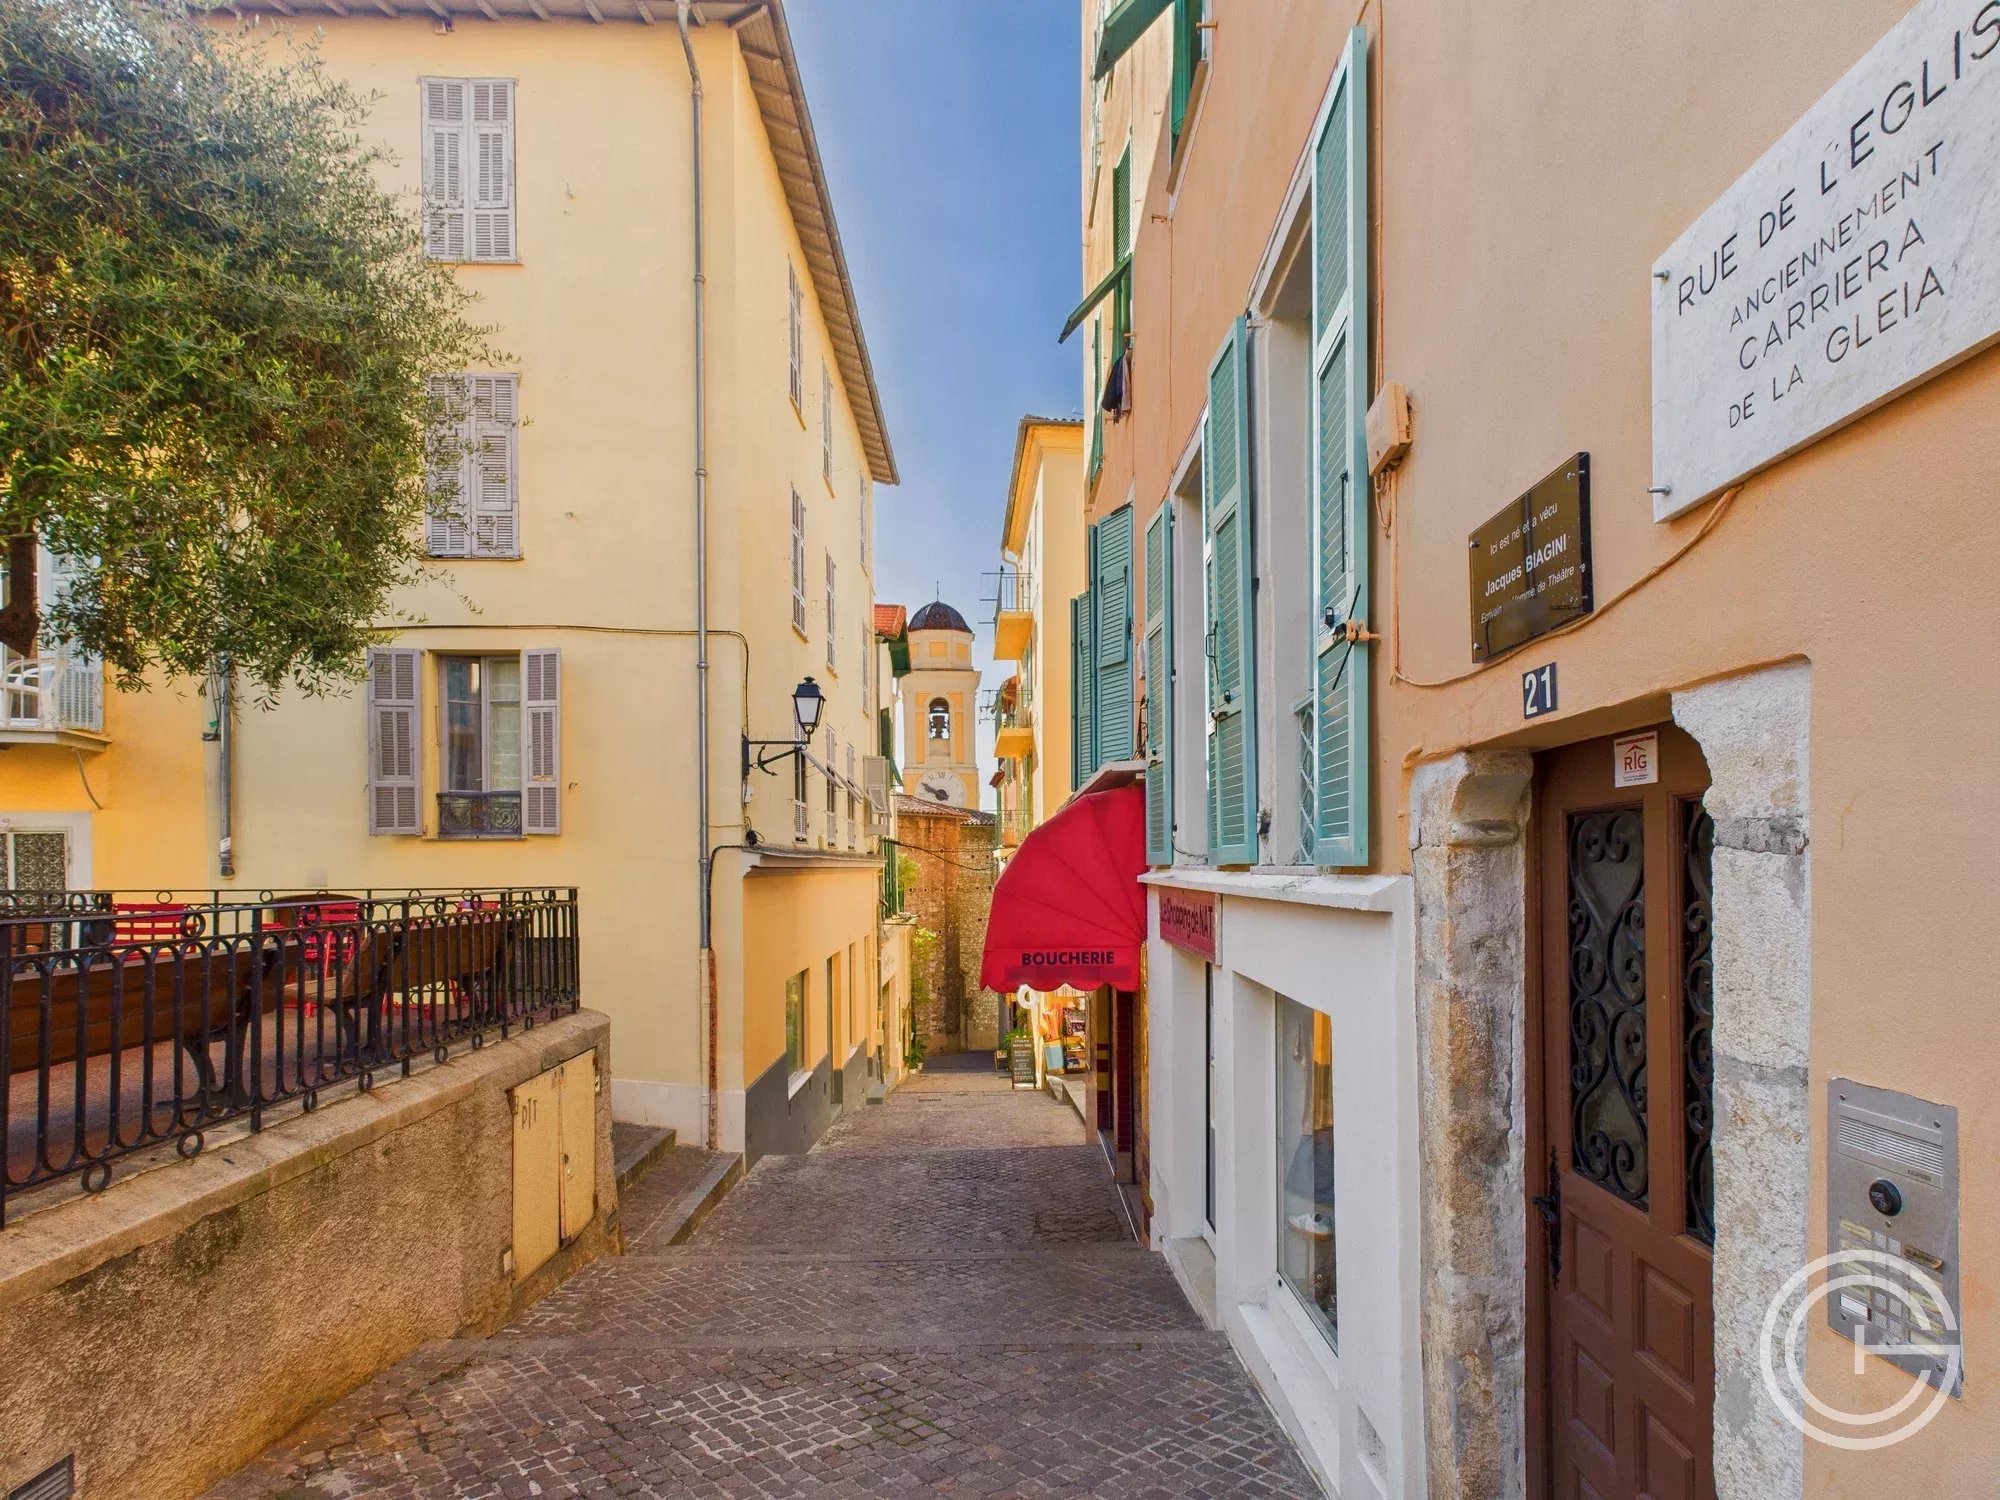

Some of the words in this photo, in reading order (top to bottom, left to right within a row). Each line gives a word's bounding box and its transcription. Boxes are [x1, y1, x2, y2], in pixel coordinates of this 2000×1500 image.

[1678, 232, 1738, 316] RUE
[1759, 187, 1796, 249] DE
[1729, 140, 1944, 333] ANCIENNEMENT
[1739, 217, 1926, 370] CARRIERA
[1729, 391, 1755, 429] DE
[1772, 363, 1804, 402] LA
[1825, 265, 1945, 364] GLEIA
[1499, 534, 1510, 550] est
[1511, 527, 1521, 543] né
[1522, 520, 1531, 535] et
[1531, 516, 1538, 528] a
[1540, 502, 1558, 522] vécu
[1484, 564, 1523, 597] Jacques
[1524, 533, 1568, 574] BIAGINI
[1536, 581, 1547, 593] de
[1547, 565, 1575, 588] Théâtre
[1524, 665, 1552, 717] 21
[1624, 751, 1647, 771] RIG
[1021, 950, 1116, 967] BOUCHERIE
